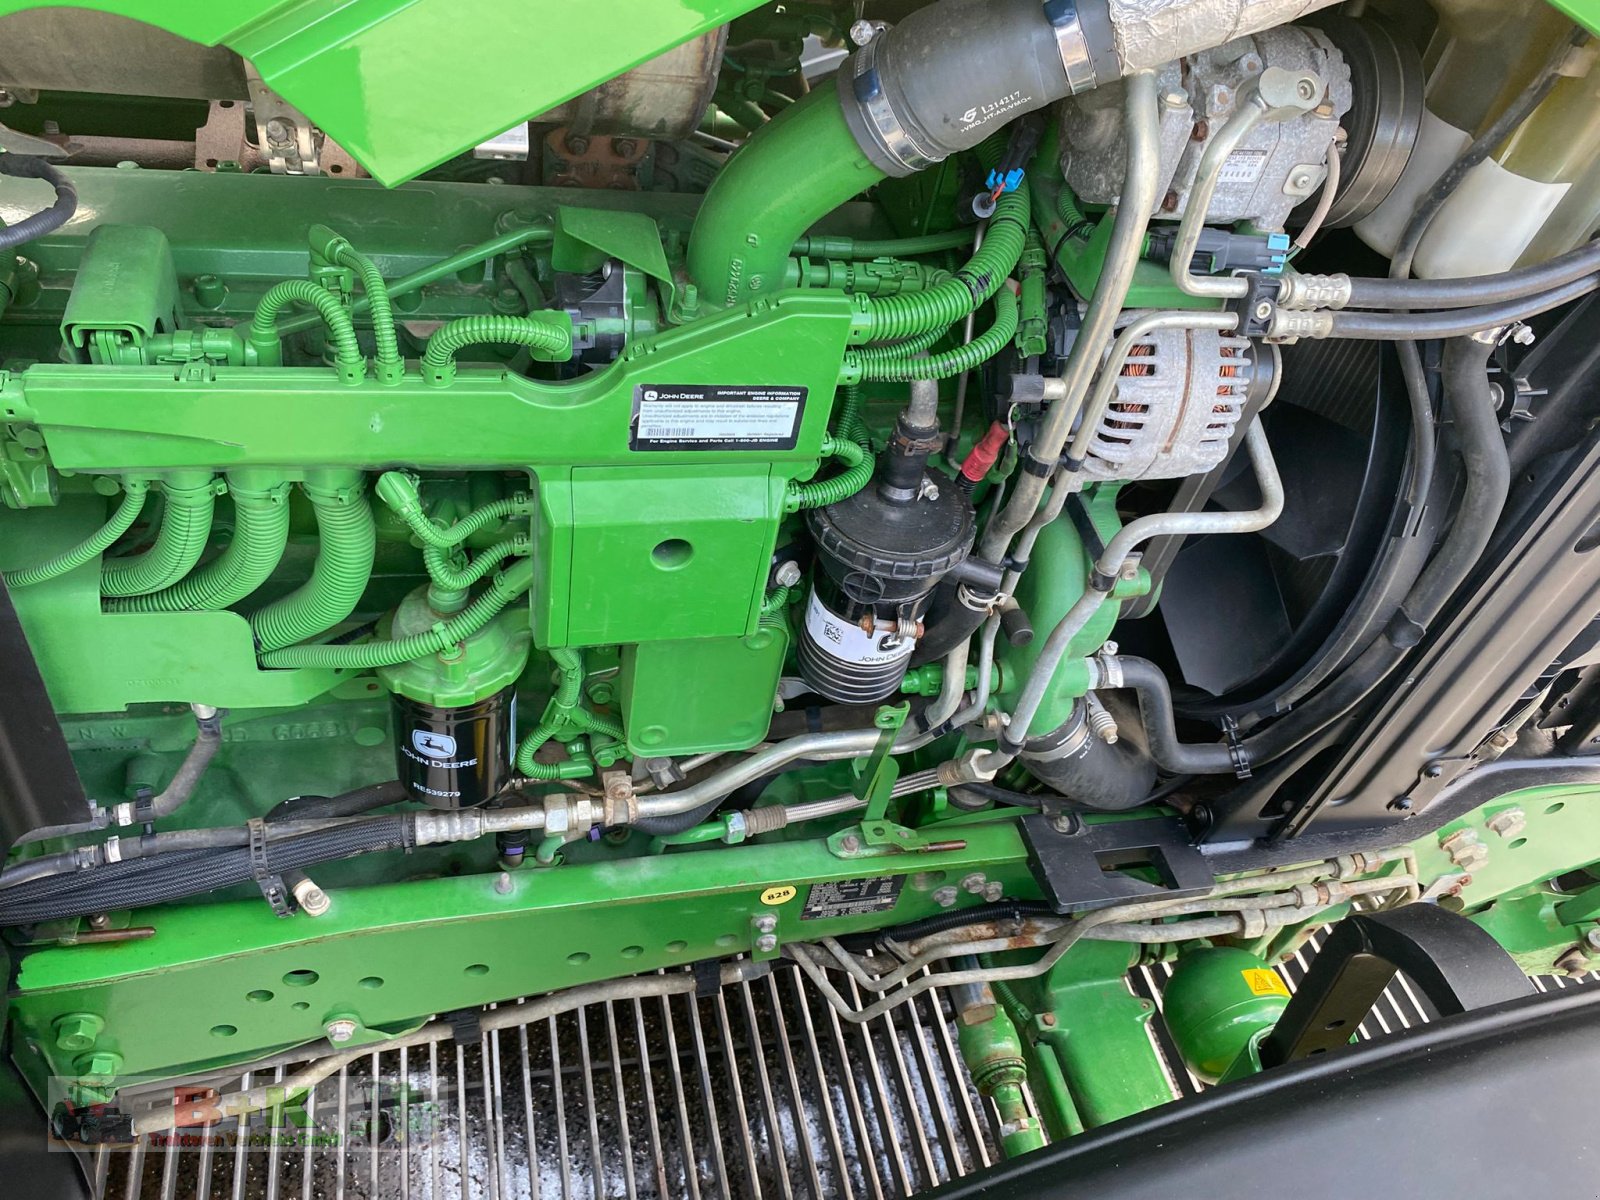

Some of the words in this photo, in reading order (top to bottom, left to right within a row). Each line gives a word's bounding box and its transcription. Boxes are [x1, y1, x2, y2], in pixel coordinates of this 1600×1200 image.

[980, 90, 1021, 115] L214217
[400, 745, 429, 765] JOHN
[431, 758, 478, 769] DEERE
[413, 782, 461, 797] RE539279
[767, 889, 791, 901] 828
